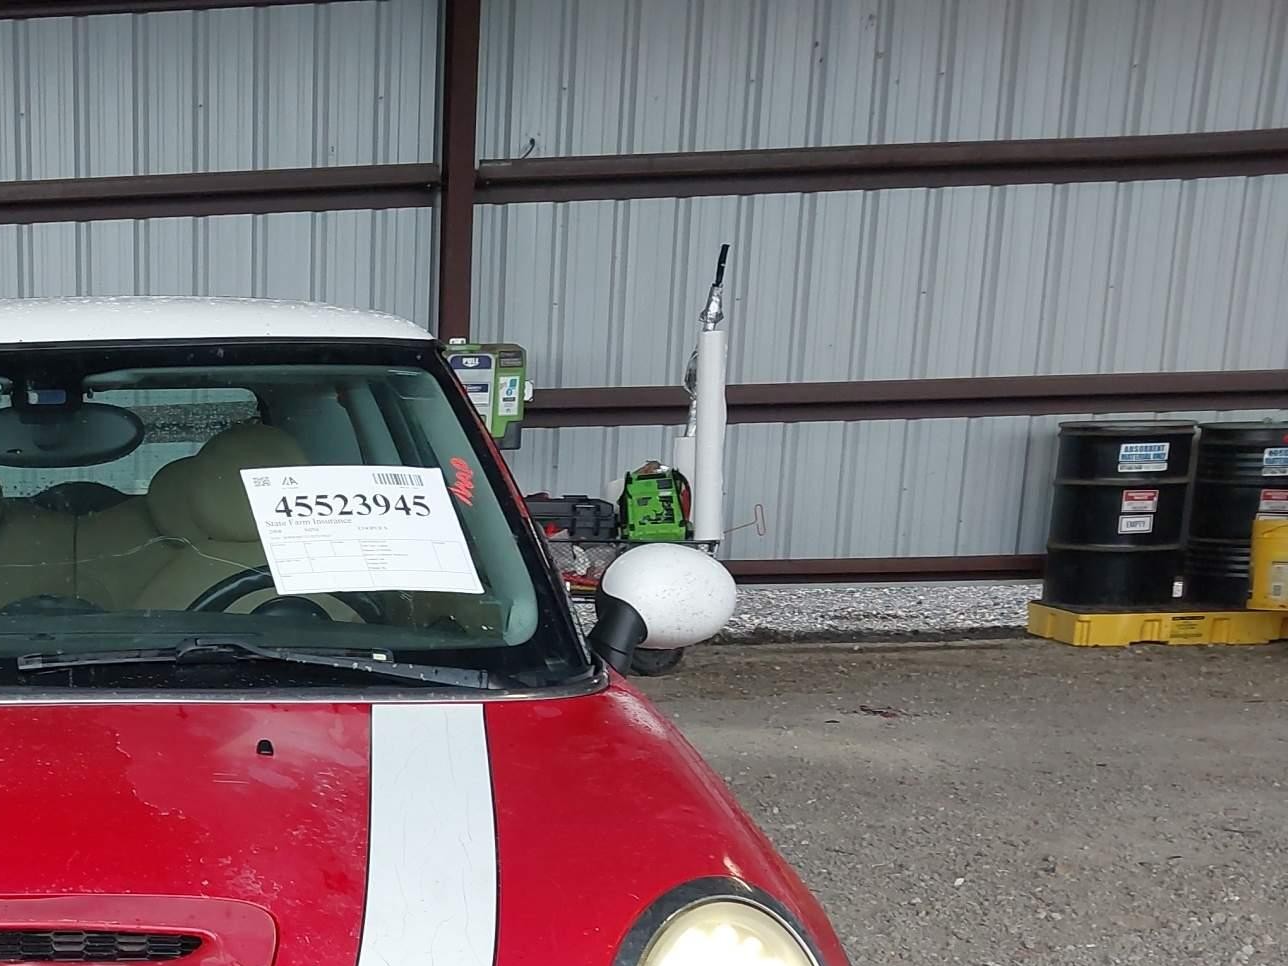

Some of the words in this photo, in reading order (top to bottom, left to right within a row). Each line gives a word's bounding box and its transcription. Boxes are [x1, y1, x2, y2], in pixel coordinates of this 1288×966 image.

[274, 493, 431, 518] 45523945
[265, 519, 287, 527] State
[288, 518, 311, 526] Farm
[312, 517, 353, 525] Insurance
